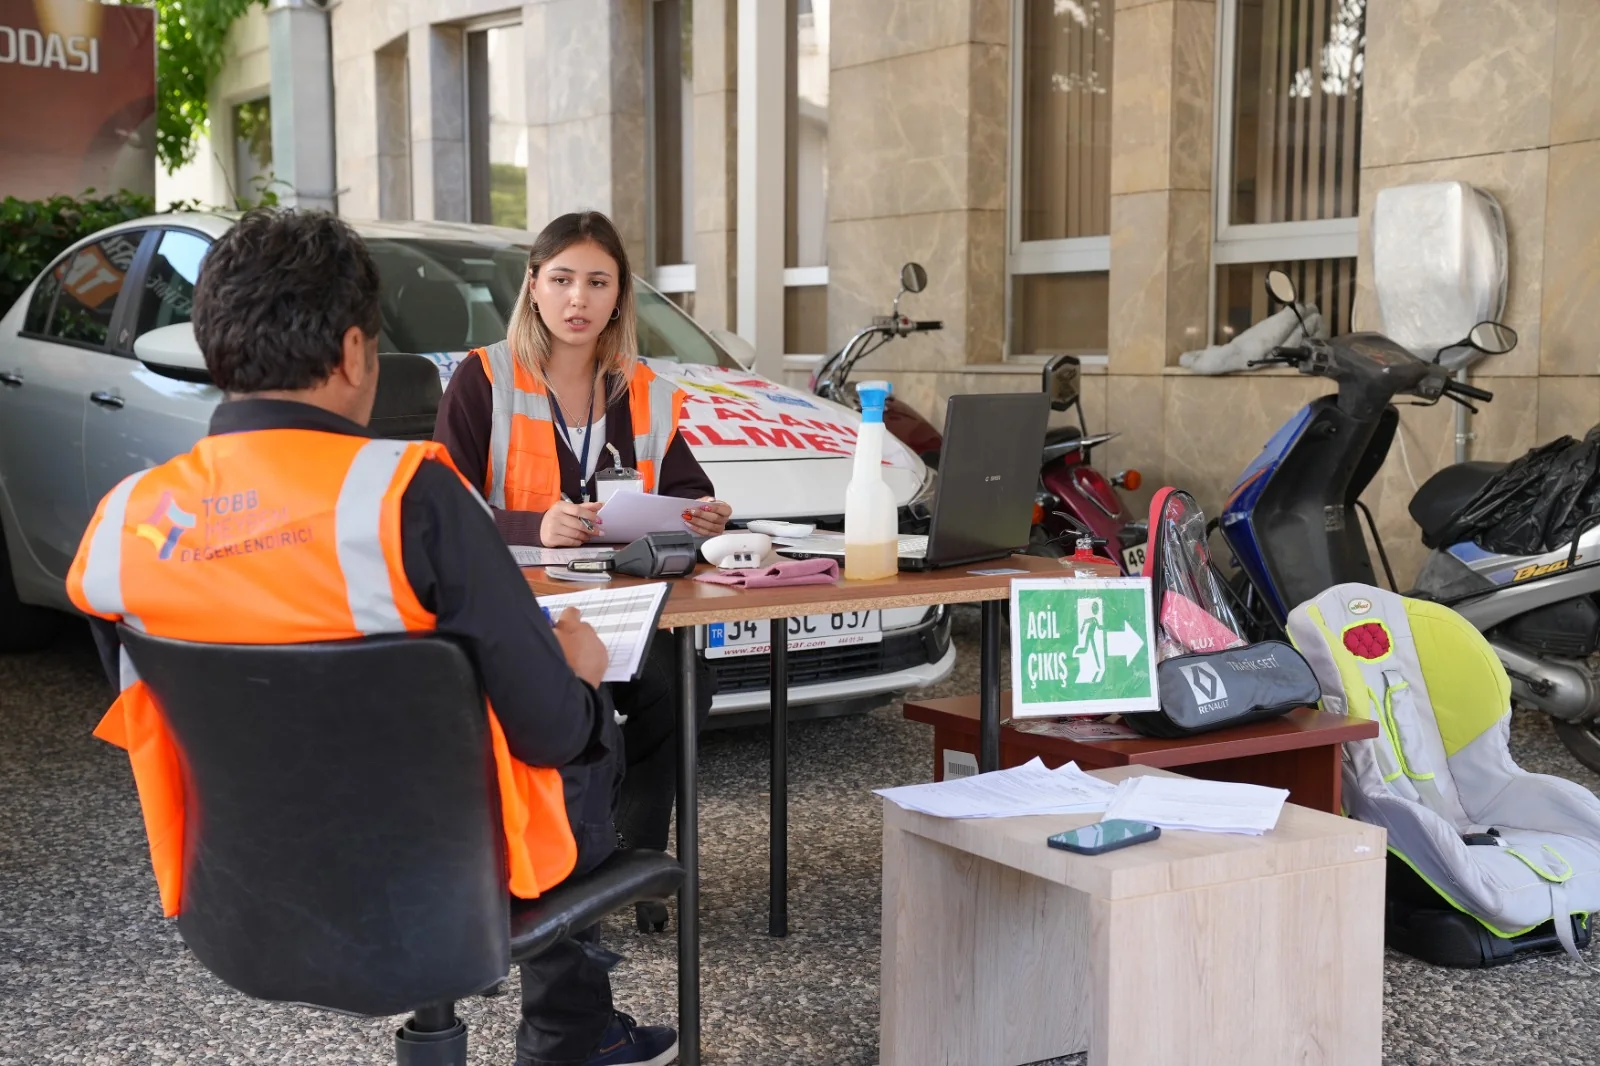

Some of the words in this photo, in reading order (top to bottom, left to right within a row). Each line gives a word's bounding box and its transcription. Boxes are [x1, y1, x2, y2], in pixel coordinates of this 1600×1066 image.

[201, 490, 257, 517] TOBB
[1128, 548, 1146, 567] 48
[1513, 555, 1582, 581] Bea
[787, 616, 816, 635] SC
[1027, 604, 1060, 639] ACİL
[711, 629, 723, 639] TR
[1027, 652, 1068, 689] ÇIKIŞ
[1259, 654, 1279, 669] SETİ
[1198, 700, 1229, 715] RENAULT
